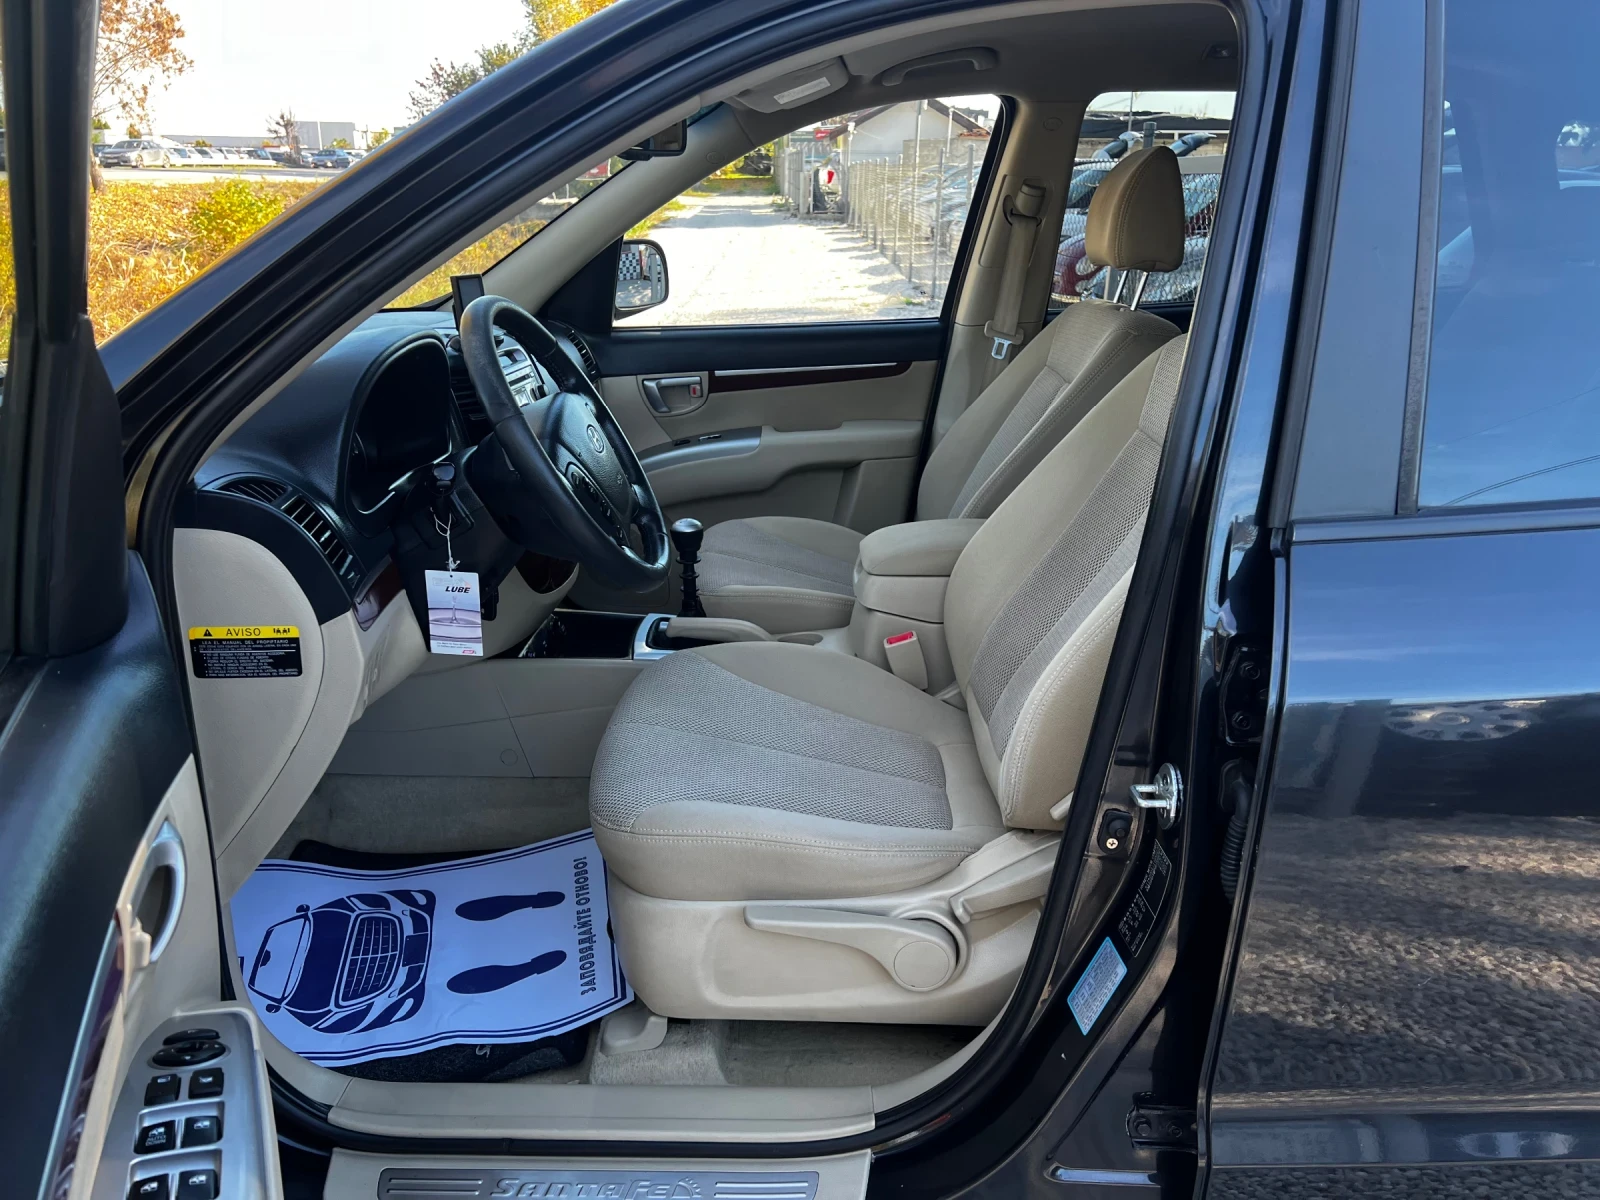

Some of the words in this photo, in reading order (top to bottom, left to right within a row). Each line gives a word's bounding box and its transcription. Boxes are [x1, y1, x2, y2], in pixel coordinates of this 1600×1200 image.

[445, 586, 471, 594] LUBE
[226, 628, 261, 636] AVISO
[573, 856, 591, 906] ОТНОВО!
[574, 907, 597, 996] ЗАПОВЯДАЙТЕ
